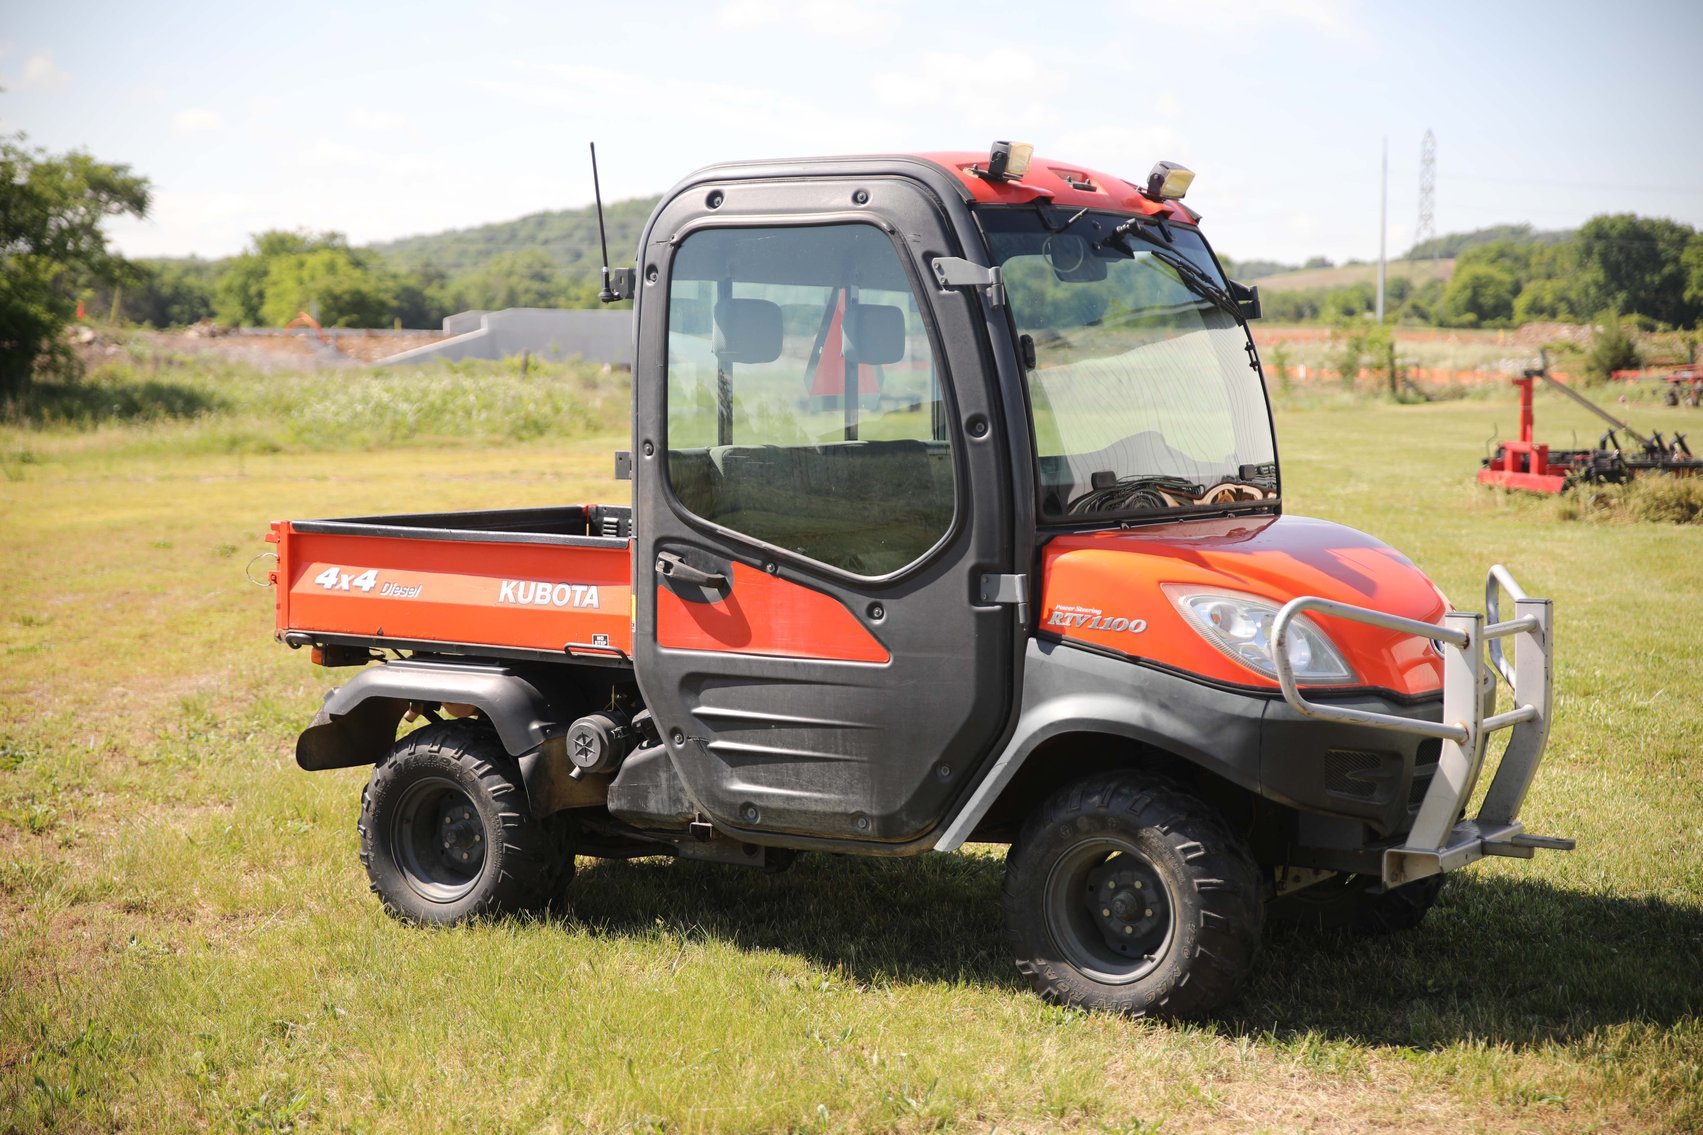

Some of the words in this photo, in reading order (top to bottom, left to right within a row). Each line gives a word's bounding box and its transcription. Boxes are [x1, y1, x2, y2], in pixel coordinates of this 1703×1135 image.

[315, 567, 378, 592] 4x4
[380, 582, 422, 598] Diesel
[498, 580, 600, 609] KUBOTA
[1047, 611, 1147, 633] RTV1100
[1055, 604, 1075, 612] Power
[1075, 606, 1103, 616] Steering
